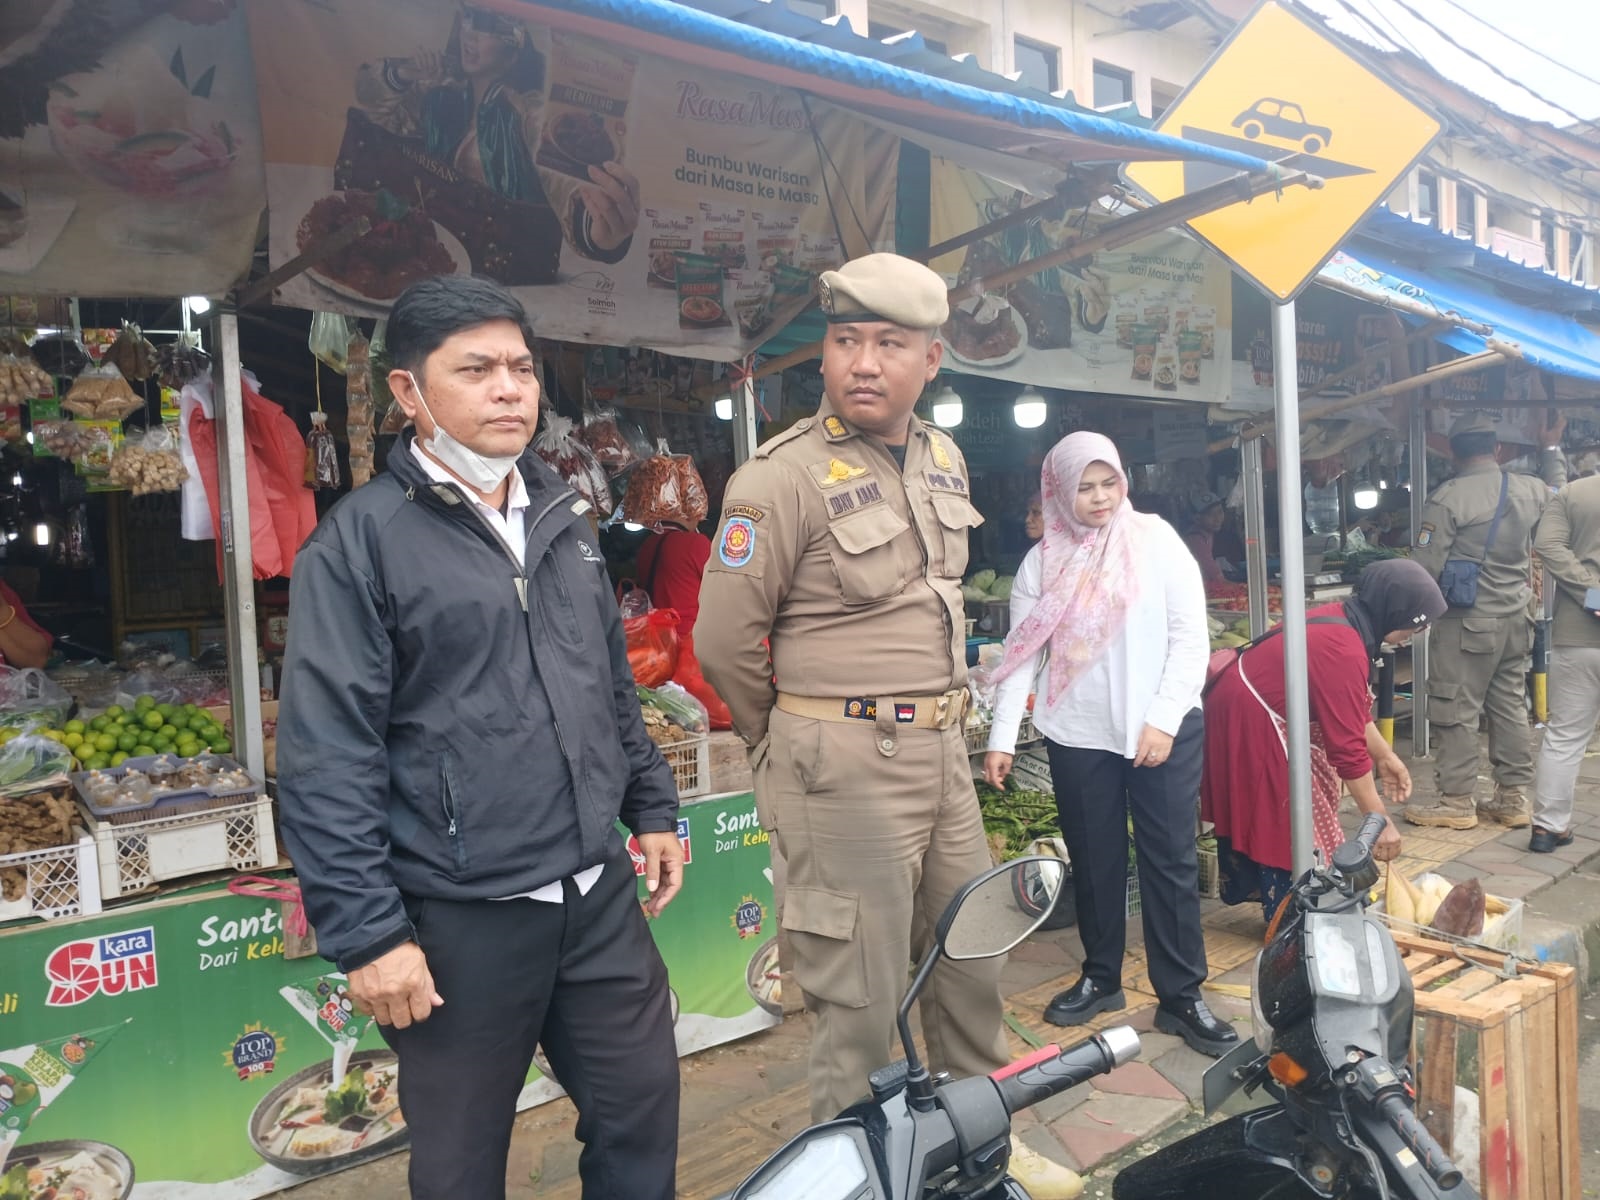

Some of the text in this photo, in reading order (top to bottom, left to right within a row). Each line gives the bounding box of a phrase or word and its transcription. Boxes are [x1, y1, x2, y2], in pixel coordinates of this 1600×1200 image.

[672, 79, 745, 123] Rasa
[686, 147, 810, 187] Bumbu Warisan
[675, 166, 819, 205] dari Masa ke Masa
[829, 482, 883, 515] IBNU ADAM
[866, 705, 877, 716] PO
[714, 807, 760, 836] Sant
[715, 836, 739, 853] Dari
[739, 906, 760, 920] TOP
[103, 934, 149, 957] kara
[199, 947, 239, 971] Dari
[236, 1036, 271, 1056] TOP
[237, 1049, 273, 1064] BRAND
[248, 1062, 265, 1073] 100
